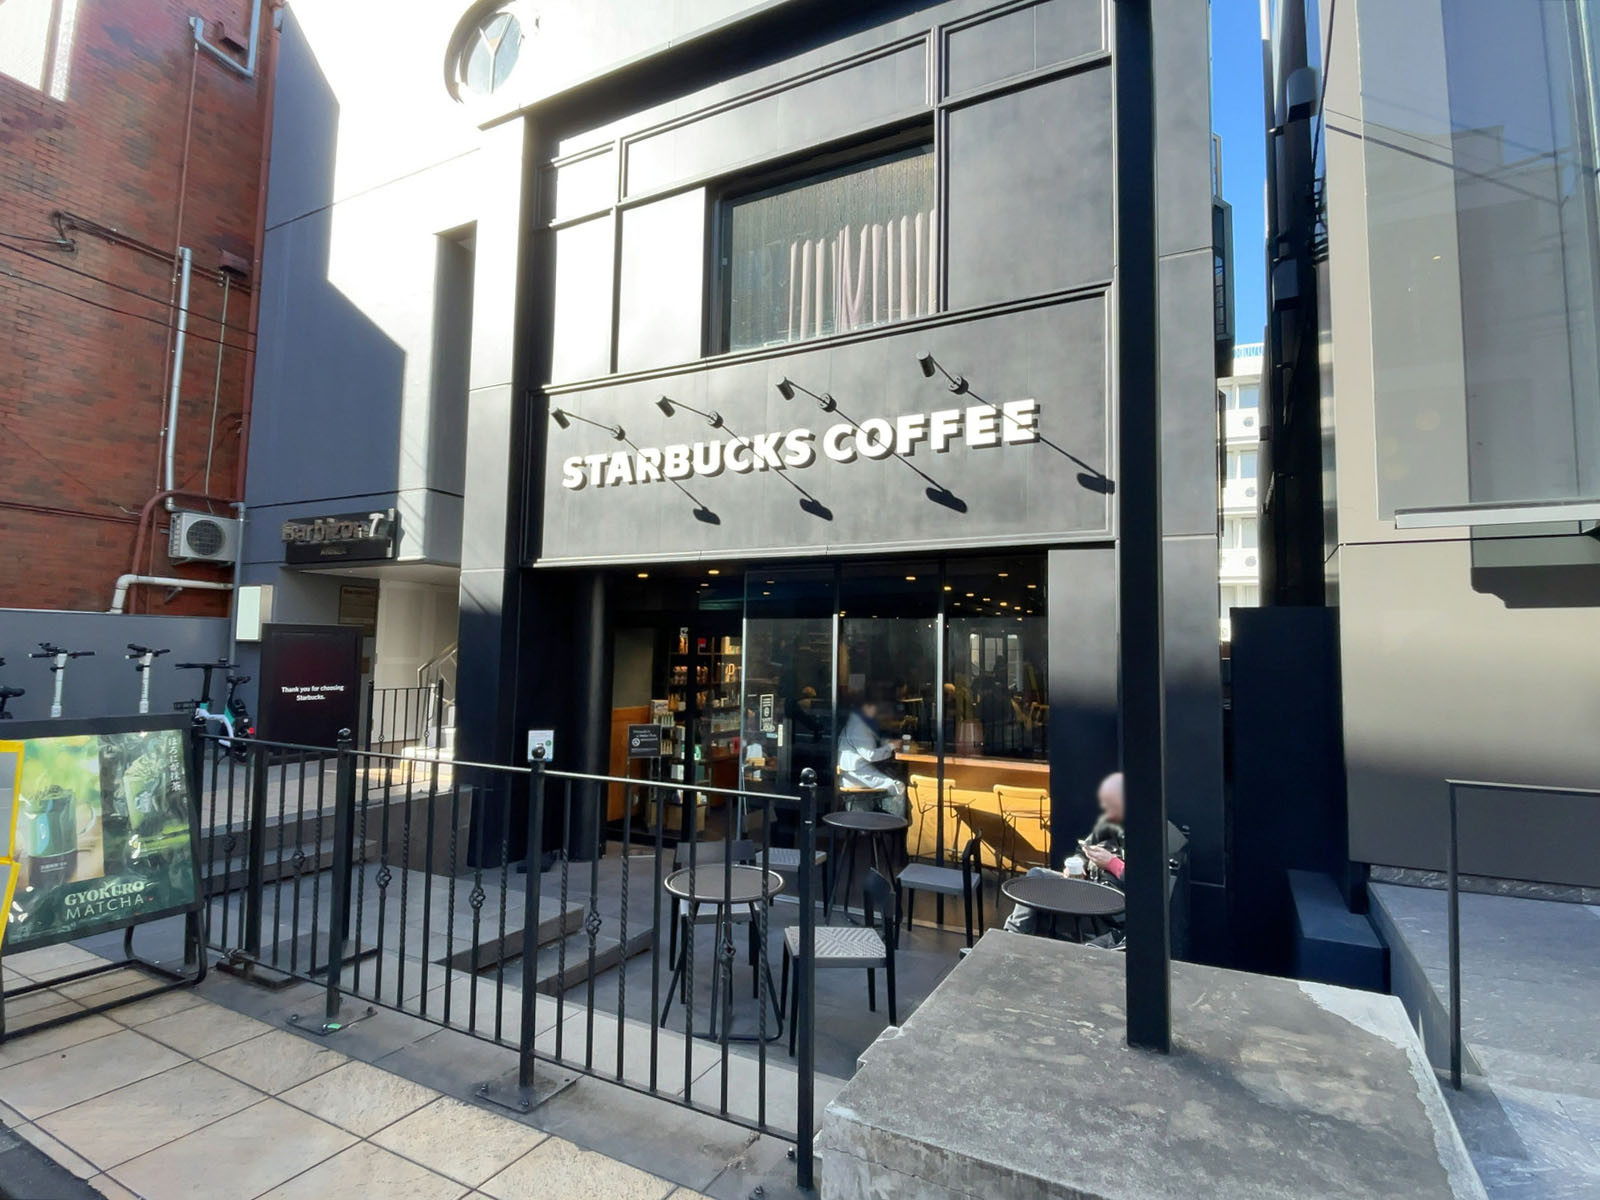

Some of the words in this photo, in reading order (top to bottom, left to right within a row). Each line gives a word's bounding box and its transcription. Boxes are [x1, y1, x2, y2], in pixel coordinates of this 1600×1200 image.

[562, 428, 814, 489] STARBUCKS
[823, 399, 1038, 462] COFFEE
[64, 880, 145, 906] GYOKURO
[66, 893, 145, 920] MATCHA
